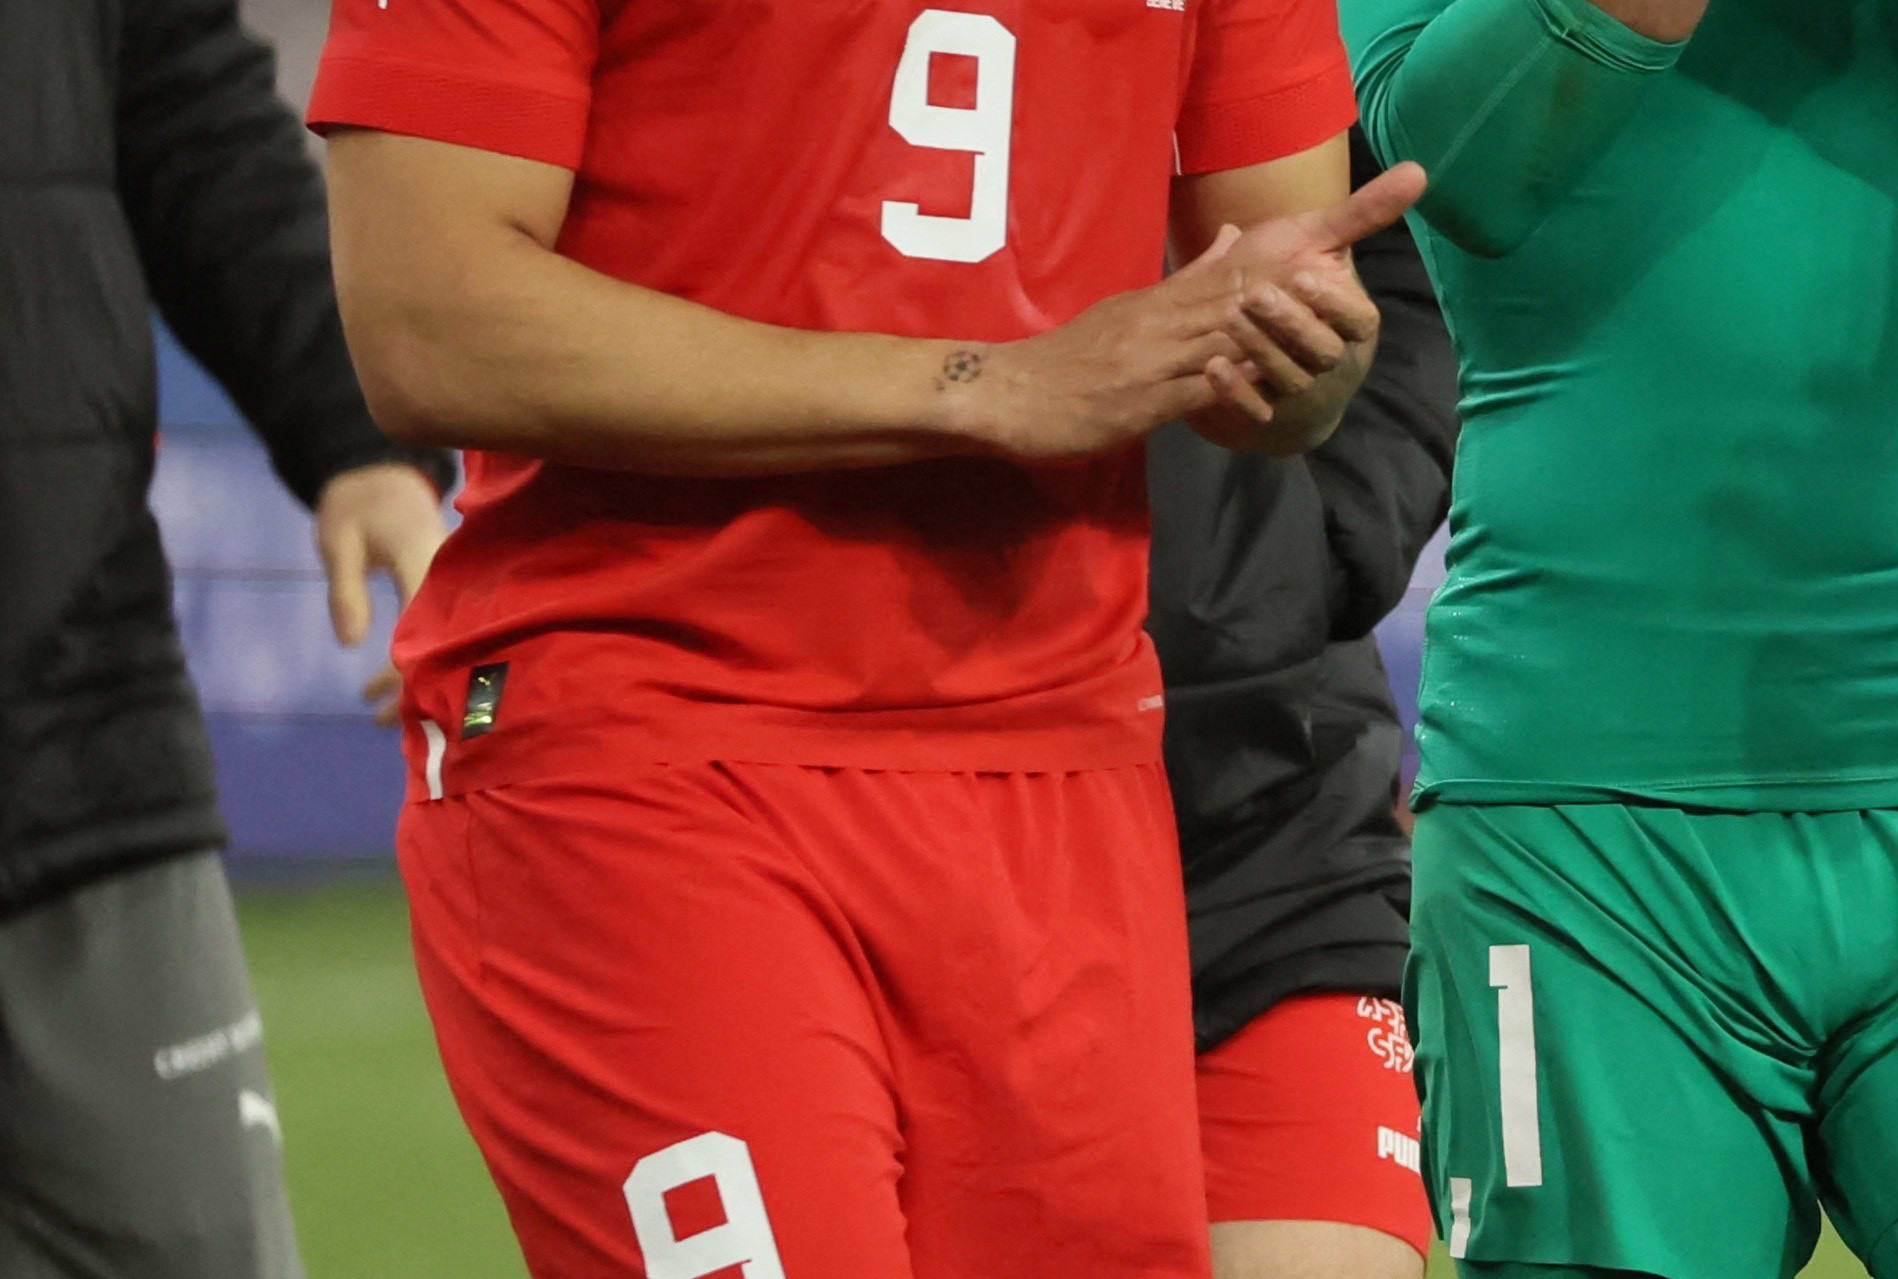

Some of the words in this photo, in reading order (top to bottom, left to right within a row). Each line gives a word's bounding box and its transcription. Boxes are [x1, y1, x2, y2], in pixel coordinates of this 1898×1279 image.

[881, 9, 1016, 263] 9
[1377, 1125, 1421, 1176] PUM
[1489, 944, 1543, 1187] 1
[622, 1130, 788, 1279] 9
